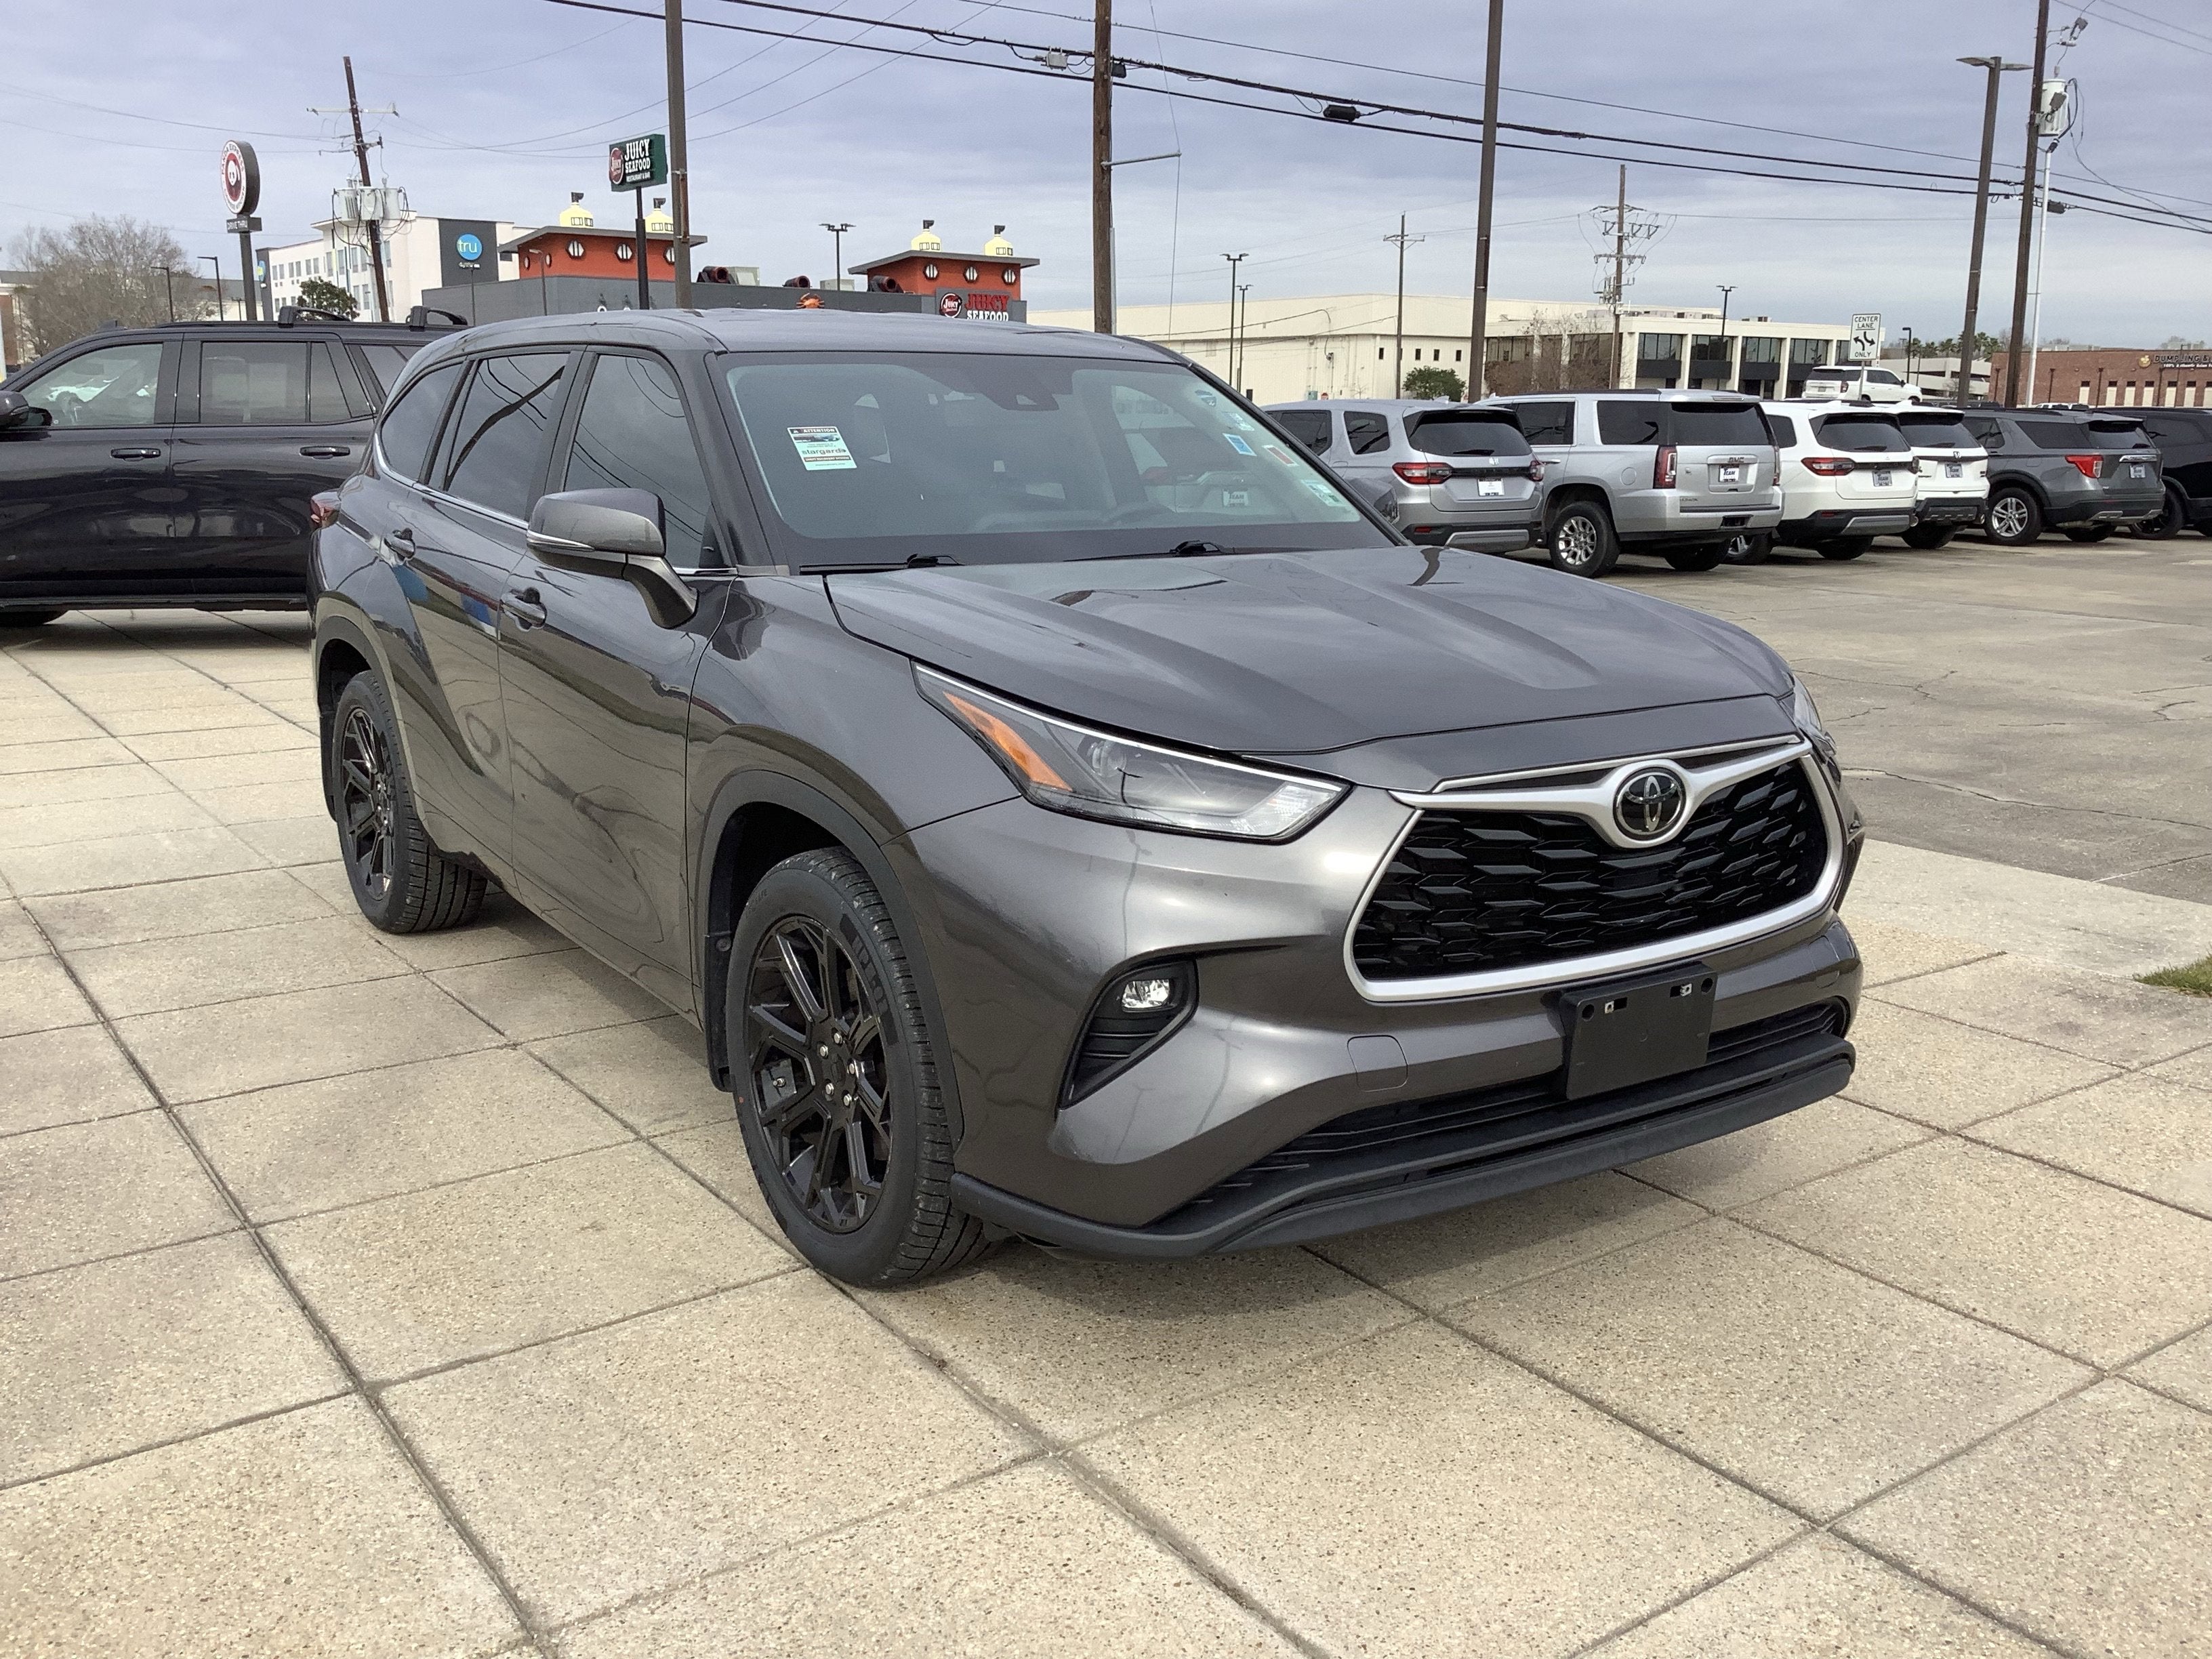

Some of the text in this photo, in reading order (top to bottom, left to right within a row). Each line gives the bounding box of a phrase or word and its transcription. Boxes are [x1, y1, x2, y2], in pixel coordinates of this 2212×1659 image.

[624, 138, 650, 161] JUICY
[625, 157, 651, 173] SEAFOOD
[458, 239, 477, 253] tru
[964, 293, 1009, 311] JUICY
[966, 310, 1009, 322] SEAFOOD
